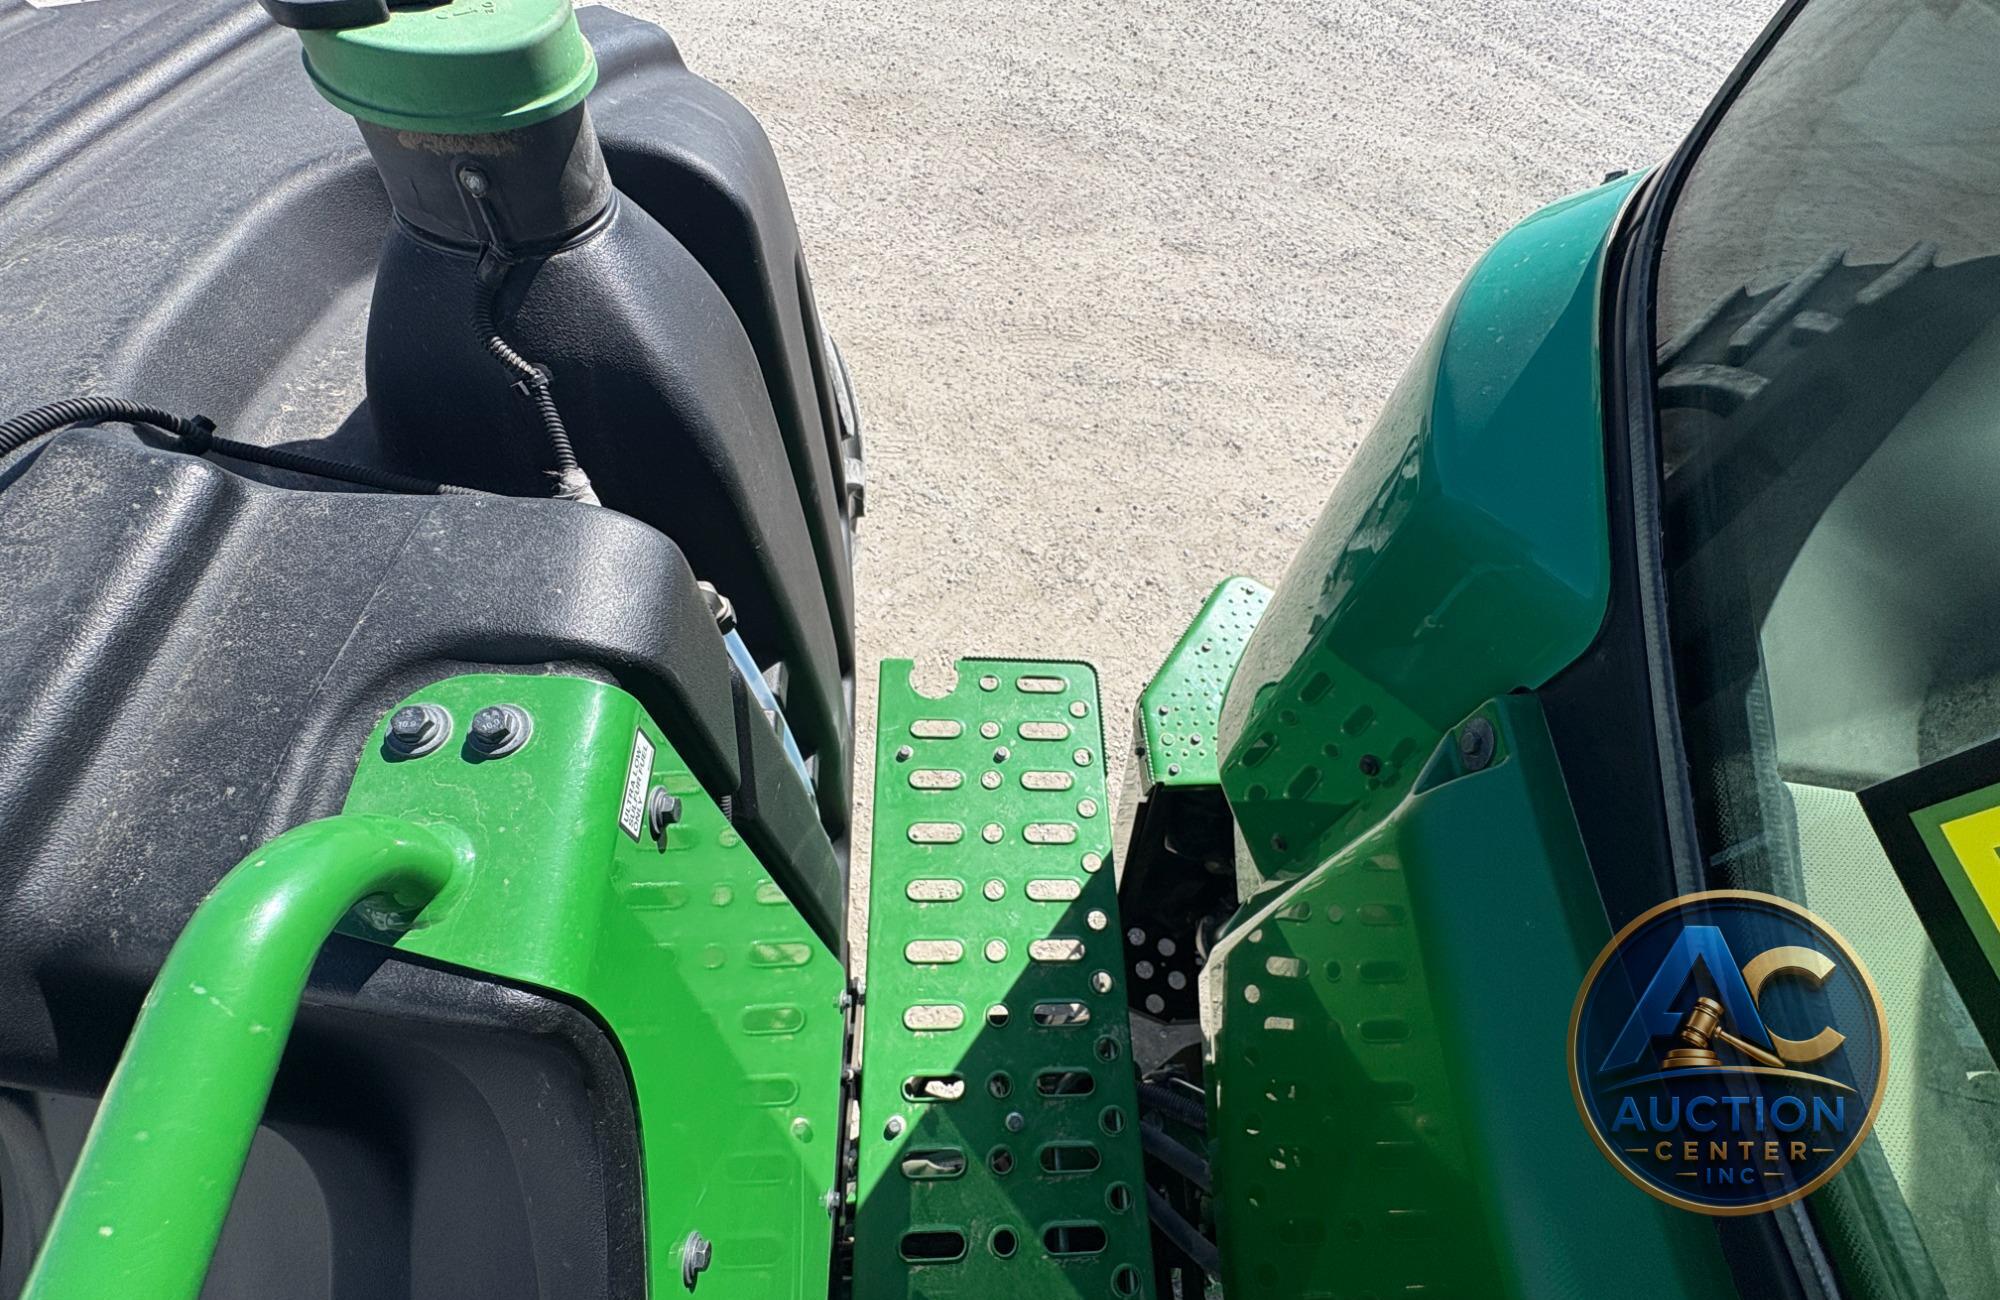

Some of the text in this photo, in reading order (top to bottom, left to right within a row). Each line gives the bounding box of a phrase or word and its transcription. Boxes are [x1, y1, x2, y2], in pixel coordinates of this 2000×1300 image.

[624, 745, 642, 823] ULTRA LOW
[628, 744, 649, 829] SULFUR FUEL
[634, 796, 643, 832] ONLY
